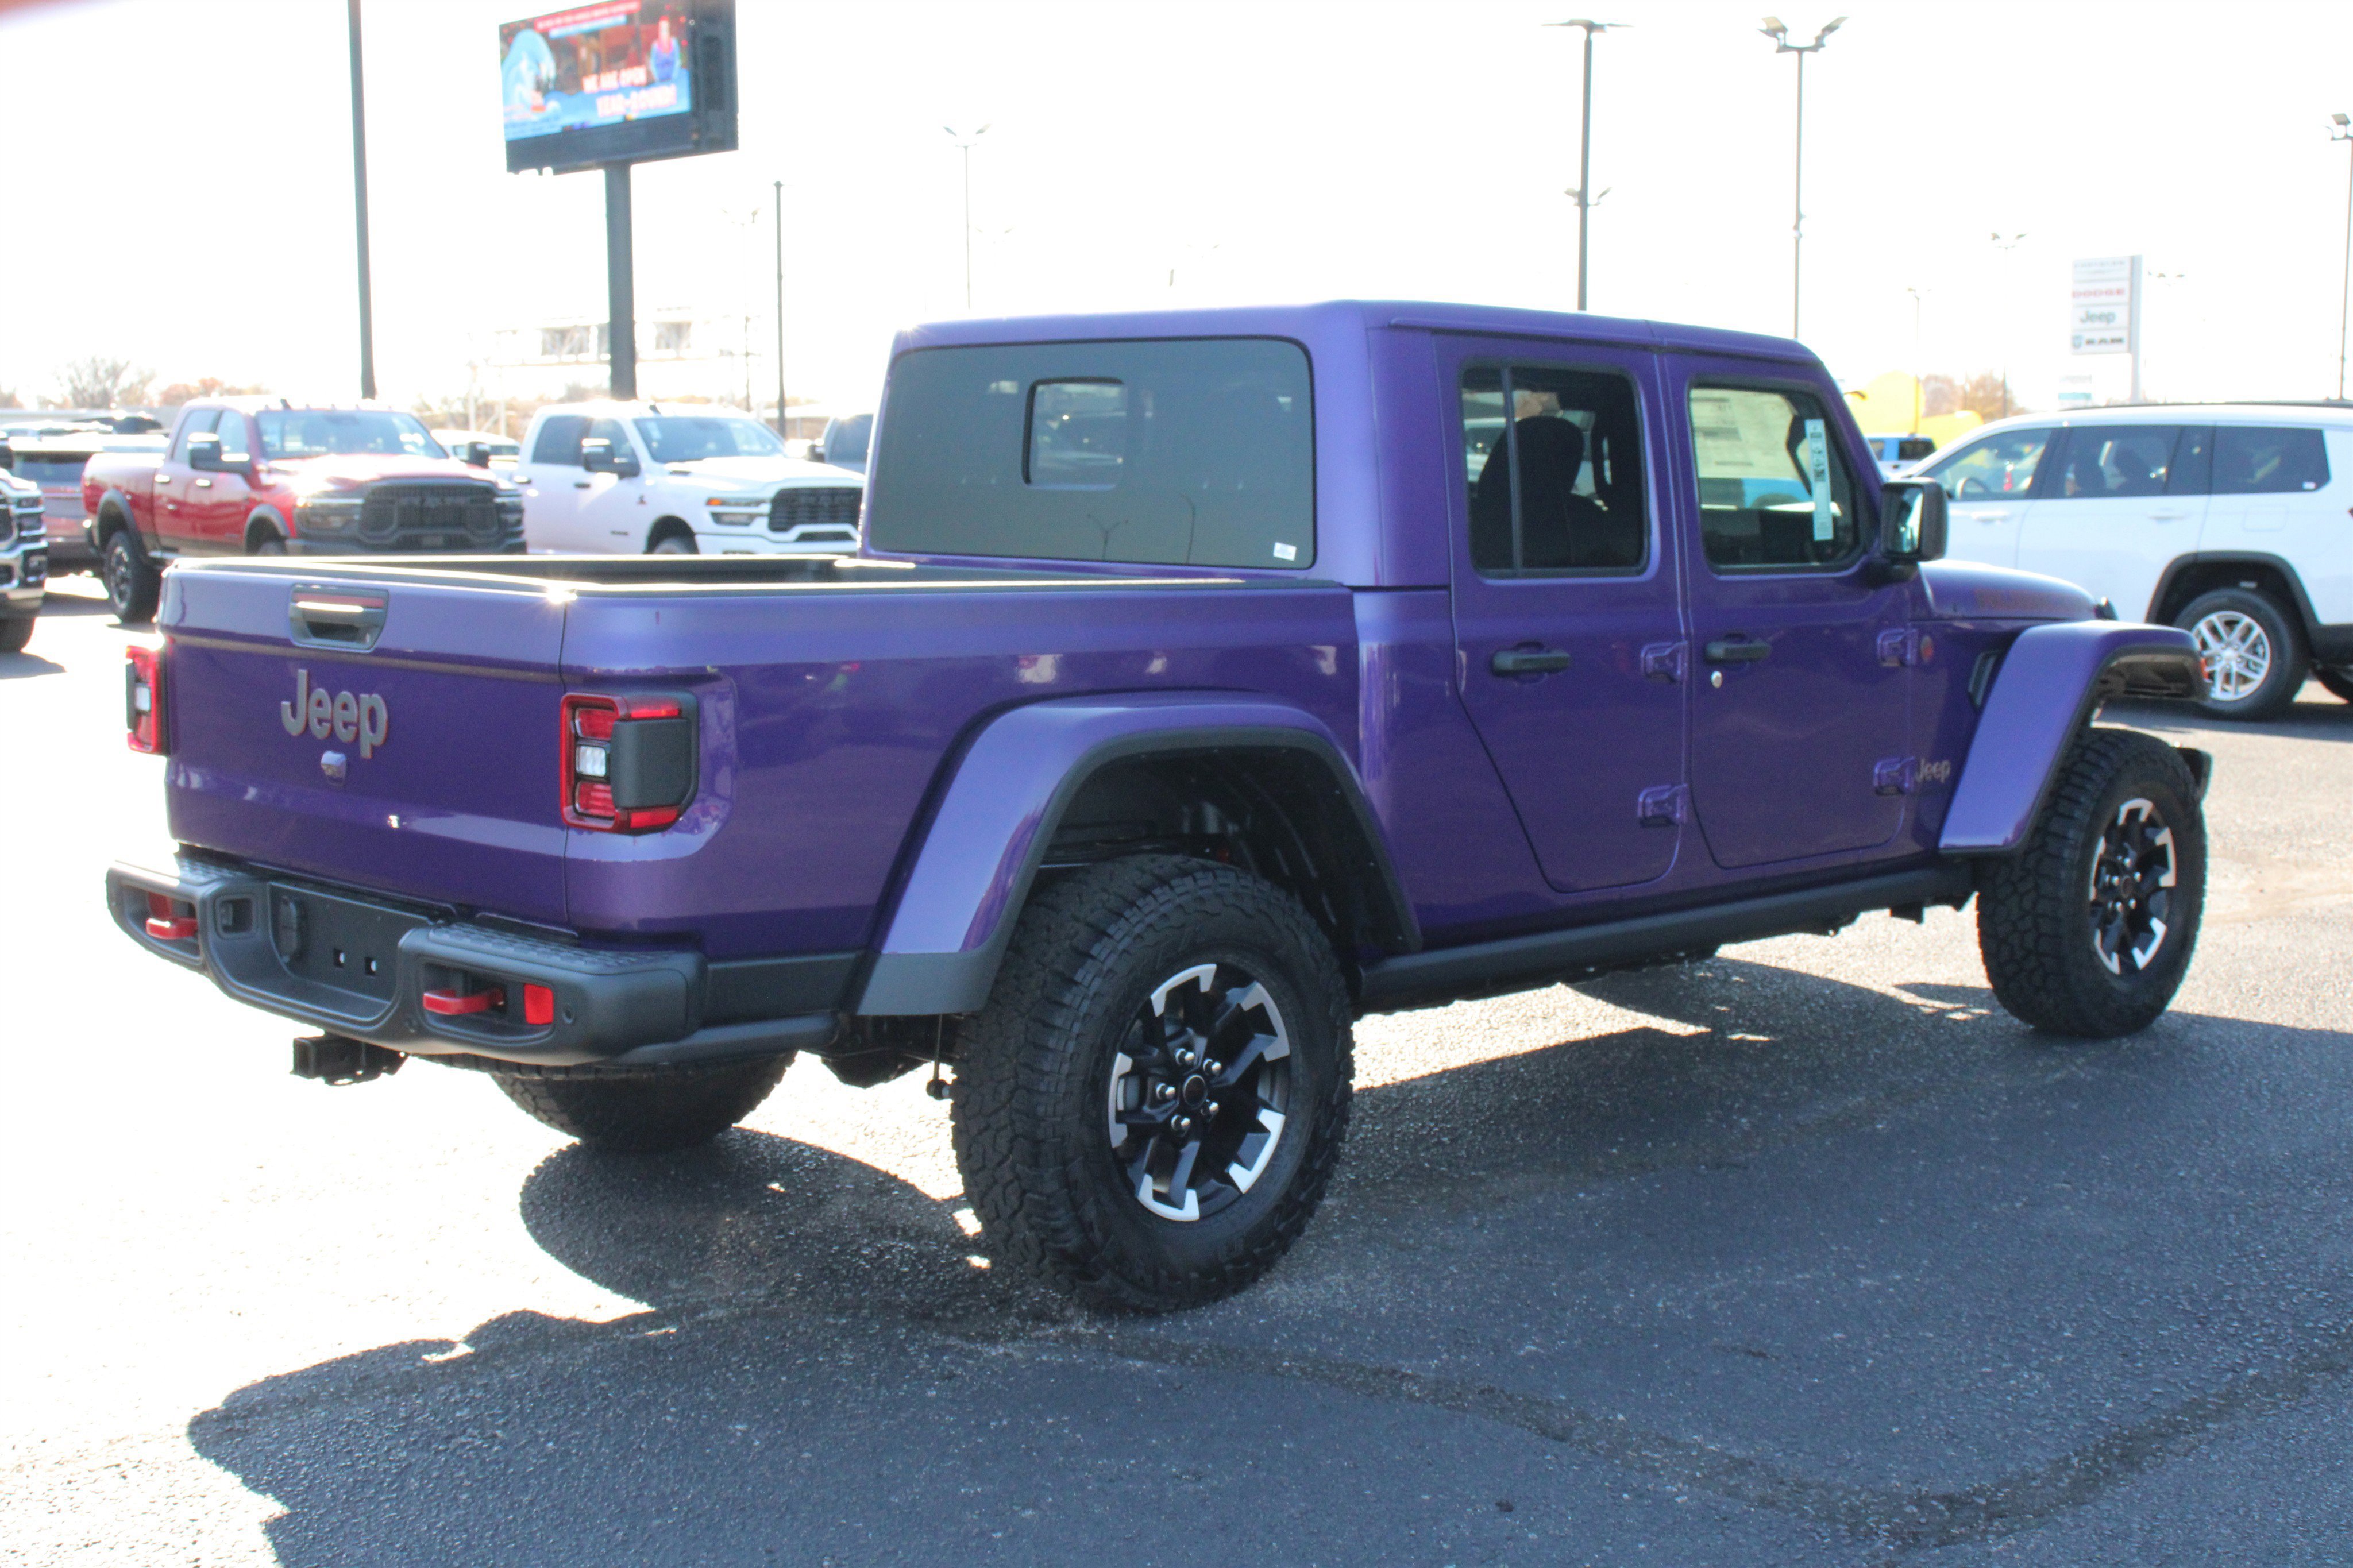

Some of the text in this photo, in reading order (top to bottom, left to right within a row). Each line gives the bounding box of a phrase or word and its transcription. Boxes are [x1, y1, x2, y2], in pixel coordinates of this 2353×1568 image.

[2080, 310, 2116, 325] Jeep
[280, 668, 388, 759] Jeep
[1916, 758, 1951, 783] Jeep
